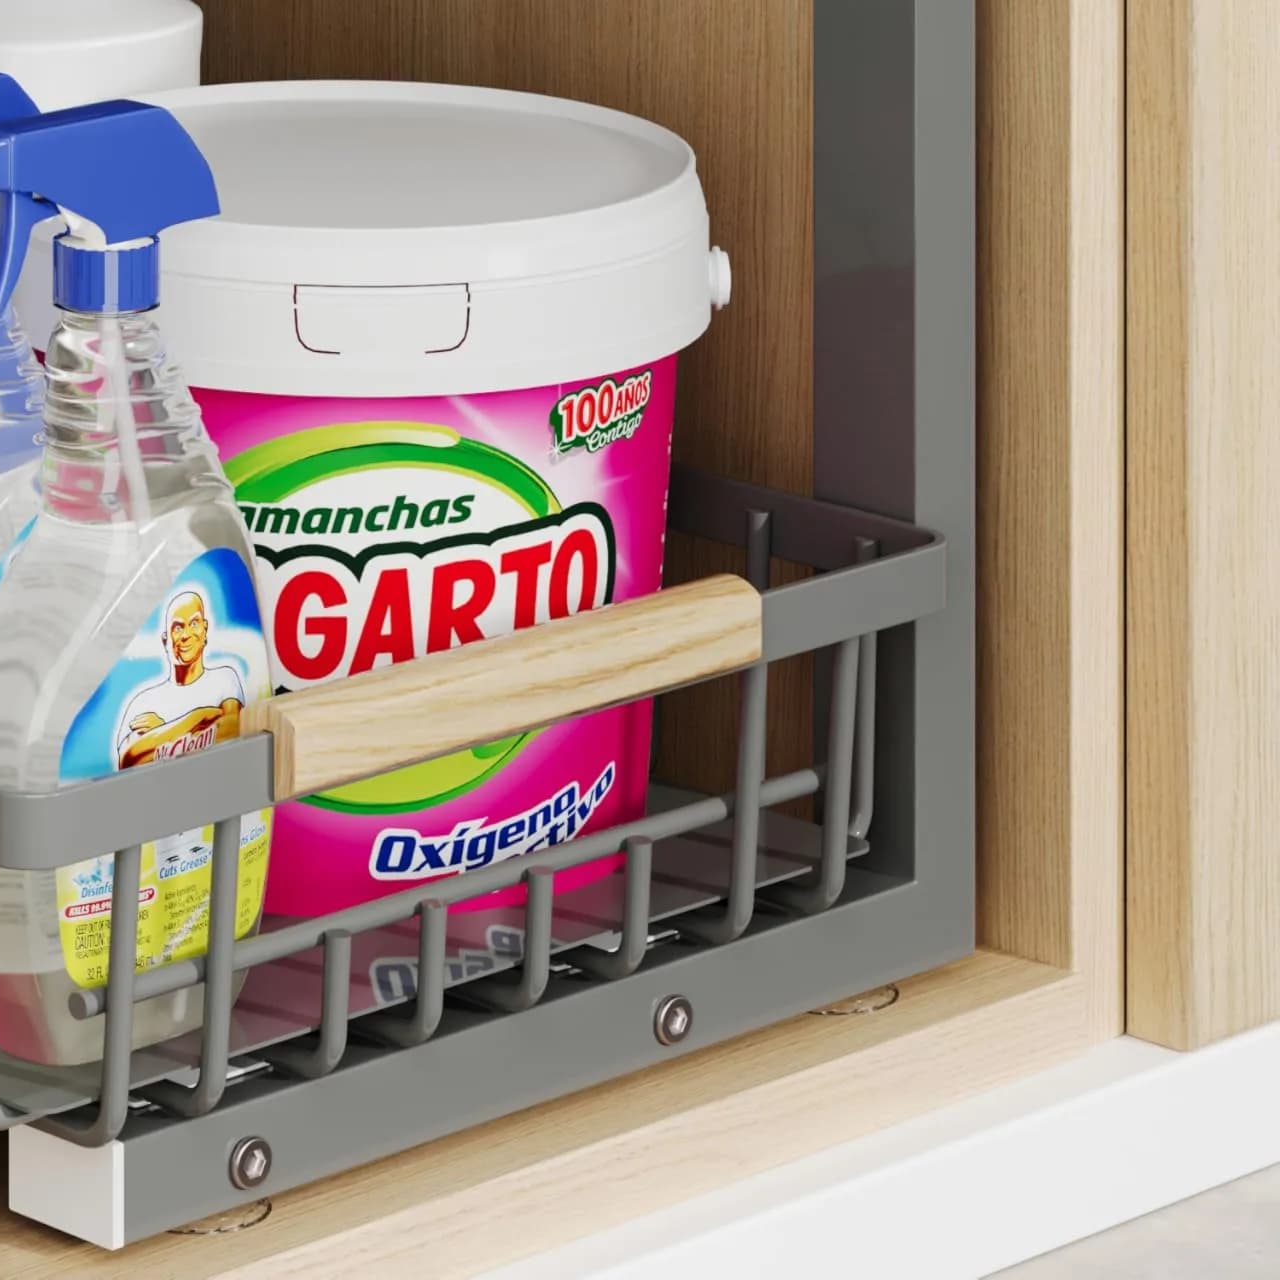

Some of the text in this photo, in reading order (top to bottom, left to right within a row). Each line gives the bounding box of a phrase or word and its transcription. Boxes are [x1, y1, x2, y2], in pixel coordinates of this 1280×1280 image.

[560, 375, 651, 441] 100 AÑOS
[586, 413, 643, 452] Contigo
[238, 494, 475, 535] amanchas
[273, 528, 598, 681] GARTO
[375, 785, 577, 874] Oxígeno
[81, 883, 113, 898] Disinfe
[160, 863, 178, 880] Cuts
[75, 932, 104, 951] CAUTION
